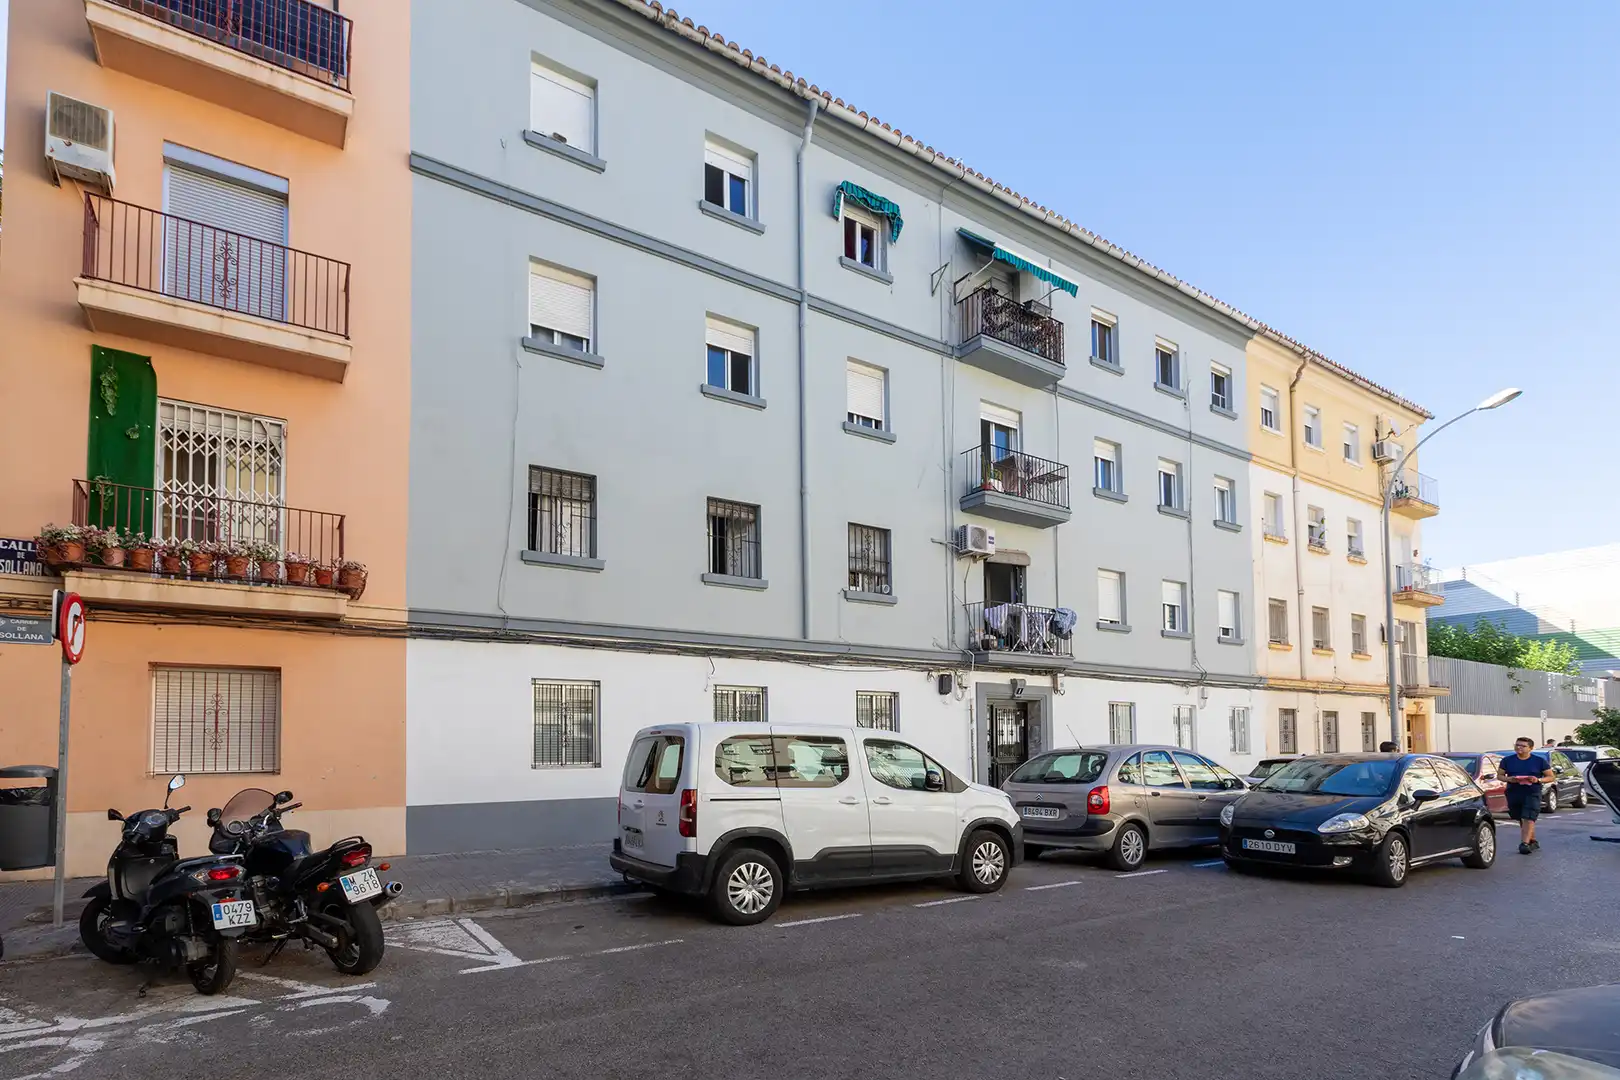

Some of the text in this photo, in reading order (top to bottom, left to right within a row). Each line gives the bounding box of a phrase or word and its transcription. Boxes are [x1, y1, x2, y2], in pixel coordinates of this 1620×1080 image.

[0, 540, 40, 552] CALL
[0, 560, 42, 576] SOLLANA
[0, 632, 44, 640] SOLLANA
[1045, 809, 1057, 817] BXR
[1248, 840, 1293, 852] 2610 DYV
[349, 870, 375, 886] M ZK
[354, 881, 380, 896] 9618
[223, 903, 252, 915] 0479
[228, 913, 251, 925] KZZ
